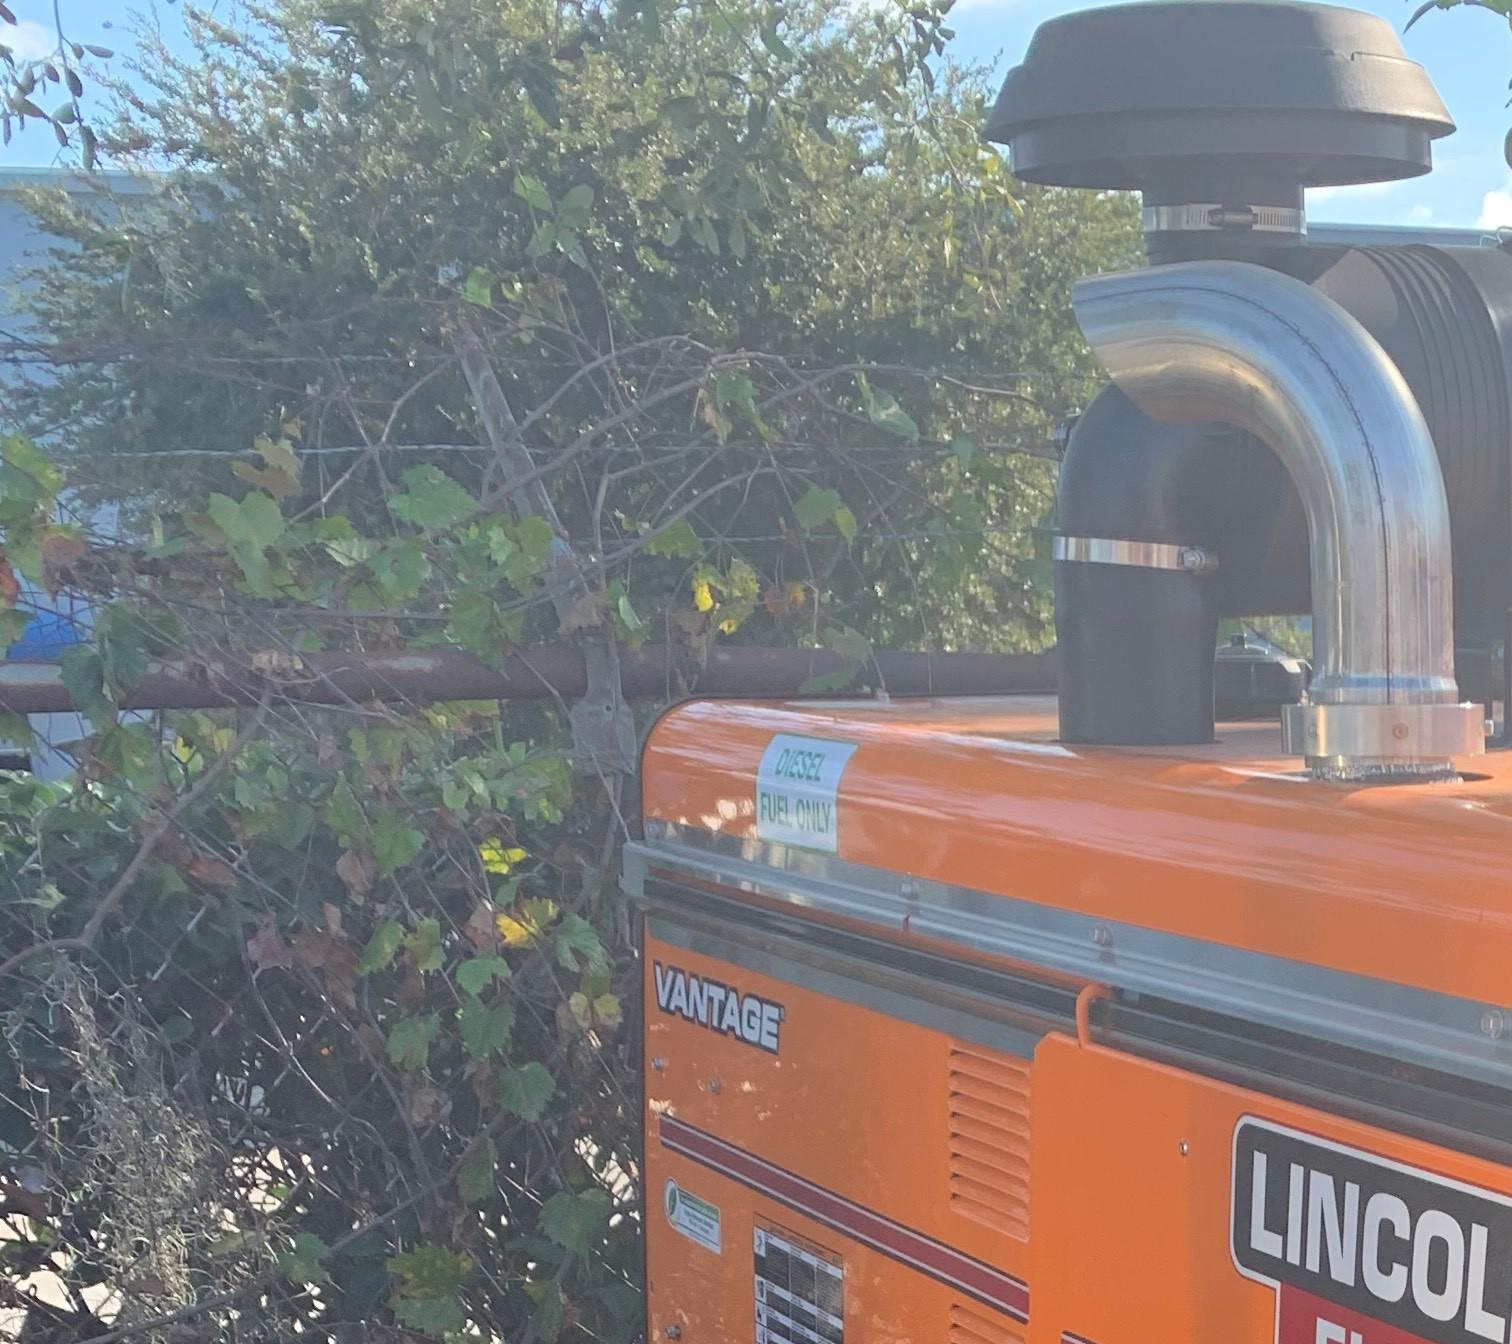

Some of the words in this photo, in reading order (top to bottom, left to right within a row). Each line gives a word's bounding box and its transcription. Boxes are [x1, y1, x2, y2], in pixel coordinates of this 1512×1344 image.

[775, 748, 823, 782] DIESEL
[760, 792, 789, 825] FUEL
[796, 799, 831, 834] ONLY
[654, 962, 784, 1054] VANTAGE
